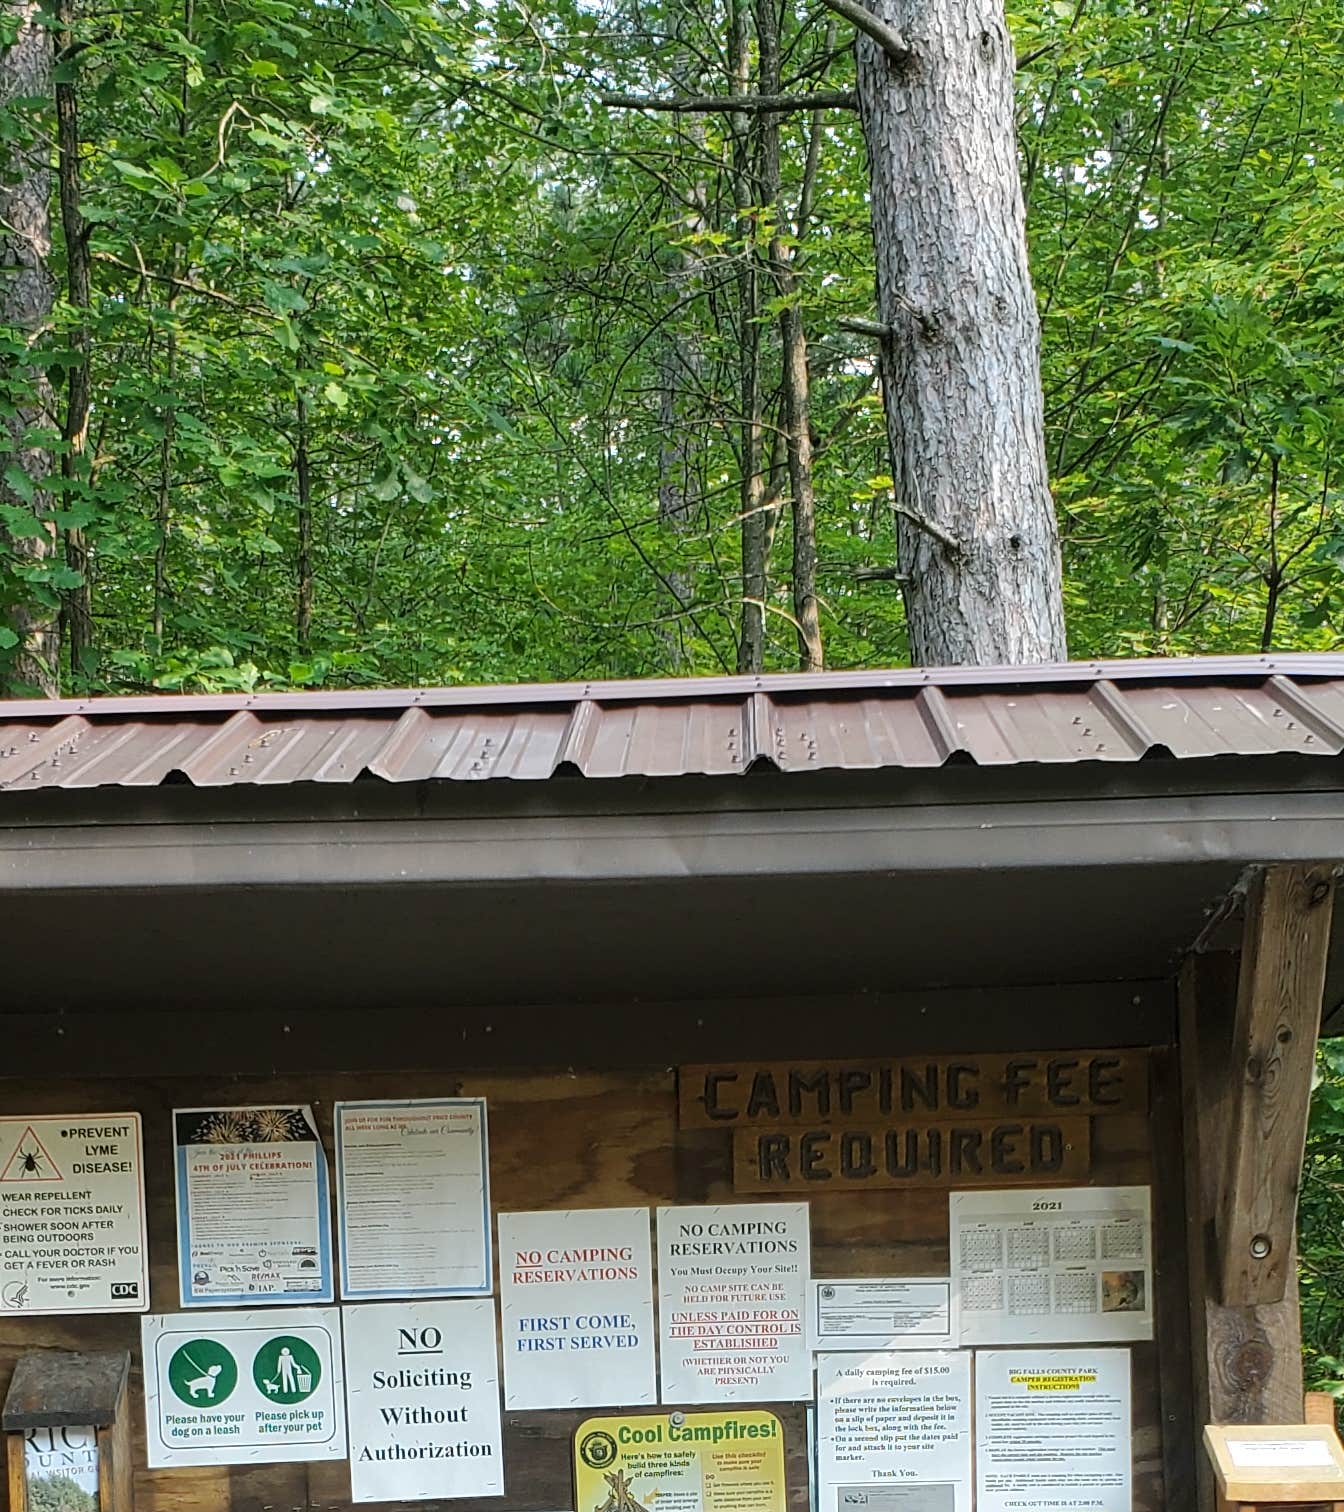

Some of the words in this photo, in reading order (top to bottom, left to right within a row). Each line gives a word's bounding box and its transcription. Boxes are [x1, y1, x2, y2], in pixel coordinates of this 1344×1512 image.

[698, 1063, 979, 1120] CAMPING
[1004, 1057, 1123, 1106] FEE
[69, 1127, 129, 1138] PREVENT
[85, 1146, 118, 1155] LYME
[759, 1125, 1062, 1182] REQUIRED
[73, 1163, 132, 1173] DISEASE!
[226, 1163, 246, 1172] JULY
[250, 1162, 312, 1170] CELEBRATION!
[2, 1193, 31, 1201] WEAR
[35, 1192, 92, 1200] REPELLENT
[3, 1208, 38, 1216] CHECK
[96, 1205, 123, 1213] DAILY
[1033, 1202, 1062, 1210] 2021
[3, 1223, 47, 1231] SHOWER
[82, 1221, 113, 1229] AFTER
[680, 1225, 703, 1237] NO
[708, 1222, 787, 1236] CAMPING
[3, 1235, 34, 1243] BEING
[37, 1233, 93, 1242] OUTDOORS
[33, 1249, 60, 1257] YOUR
[63, 1248, 104, 1256] DOCTOR
[670, 1241, 797, 1256] RESERVATIONS
[516, 1251, 542, 1264] NO
[547, 1248, 632, 1263] CAMPING
[513, 1268, 637, 1284] RESERVATIONS
[691, 1267, 712, 1275] Must
[715, 1267, 747, 1276] Occupy
[775, 1265, 797, 1273] Site!!
[112, 1284, 137, 1295] CDC
[684, 1295, 708, 1303] HELD
[672, 1312, 717, 1322] UNLESS
[722, 1312, 749, 1321] PAID
[754, 1311, 778, 1320] FOR
[781, 1310, 798, 1319] ON
[520, 1317, 570, 1331] FIRST
[576, 1315, 635, 1330] COME,
[669, 1327, 694, 1336] THE
[698, 1326, 723, 1335] DAY
[726, 1324, 787, 1334] CONTROL
[790, 1324, 801, 1332] IS
[398, 1328, 441, 1349] NO
[518, 1338, 565, 1350] FIRST
[571, 1335, 638, 1349] SERVED
[694, 1338, 778, 1349] ESTABLISHED
[683, 1357, 731, 1366] (WHETHER
[697, 1367, 716, 1375] ARE
[718, 1366, 775, 1374] PHYSICALLY
[845, 1369, 864, 1377] daily
[866, 1369, 899, 1377] camping
[924, 1367, 950, 1375] $15.00
[373, 1369, 472, 1390] Soliciting
[715, 1377, 758, 1385] PRESENT)
[881, 1378, 916, 1386] required.
[166, 1416, 197, 1424] Please
[200, 1414, 221, 1422] have
[224, 1415, 245, 1423] your
[255, 1412, 287, 1421] Please
[289, 1411, 309, 1421] pick
[311, 1412, 324, 1420] up
[380, 1406, 468, 1425] Without
[172, 1428, 189, 1438] dog
[214, 1425, 240, 1434] leash
[259, 1423, 282, 1433] after
[284, 1424, 304, 1433] your
[306, 1422, 322, 1432] pet
[619, 1425, 661, 1444] Cool
[668, 1420, 776, 1443] Campfires!
[359, 1441, 492, 1461] Authorization
[621, 1452, 645, 1461] Here's
[647, 1452, 662, 1460] how
[674, 1451, 695, 1460] safely
[646, 1469, 683, 1479] campfires:
